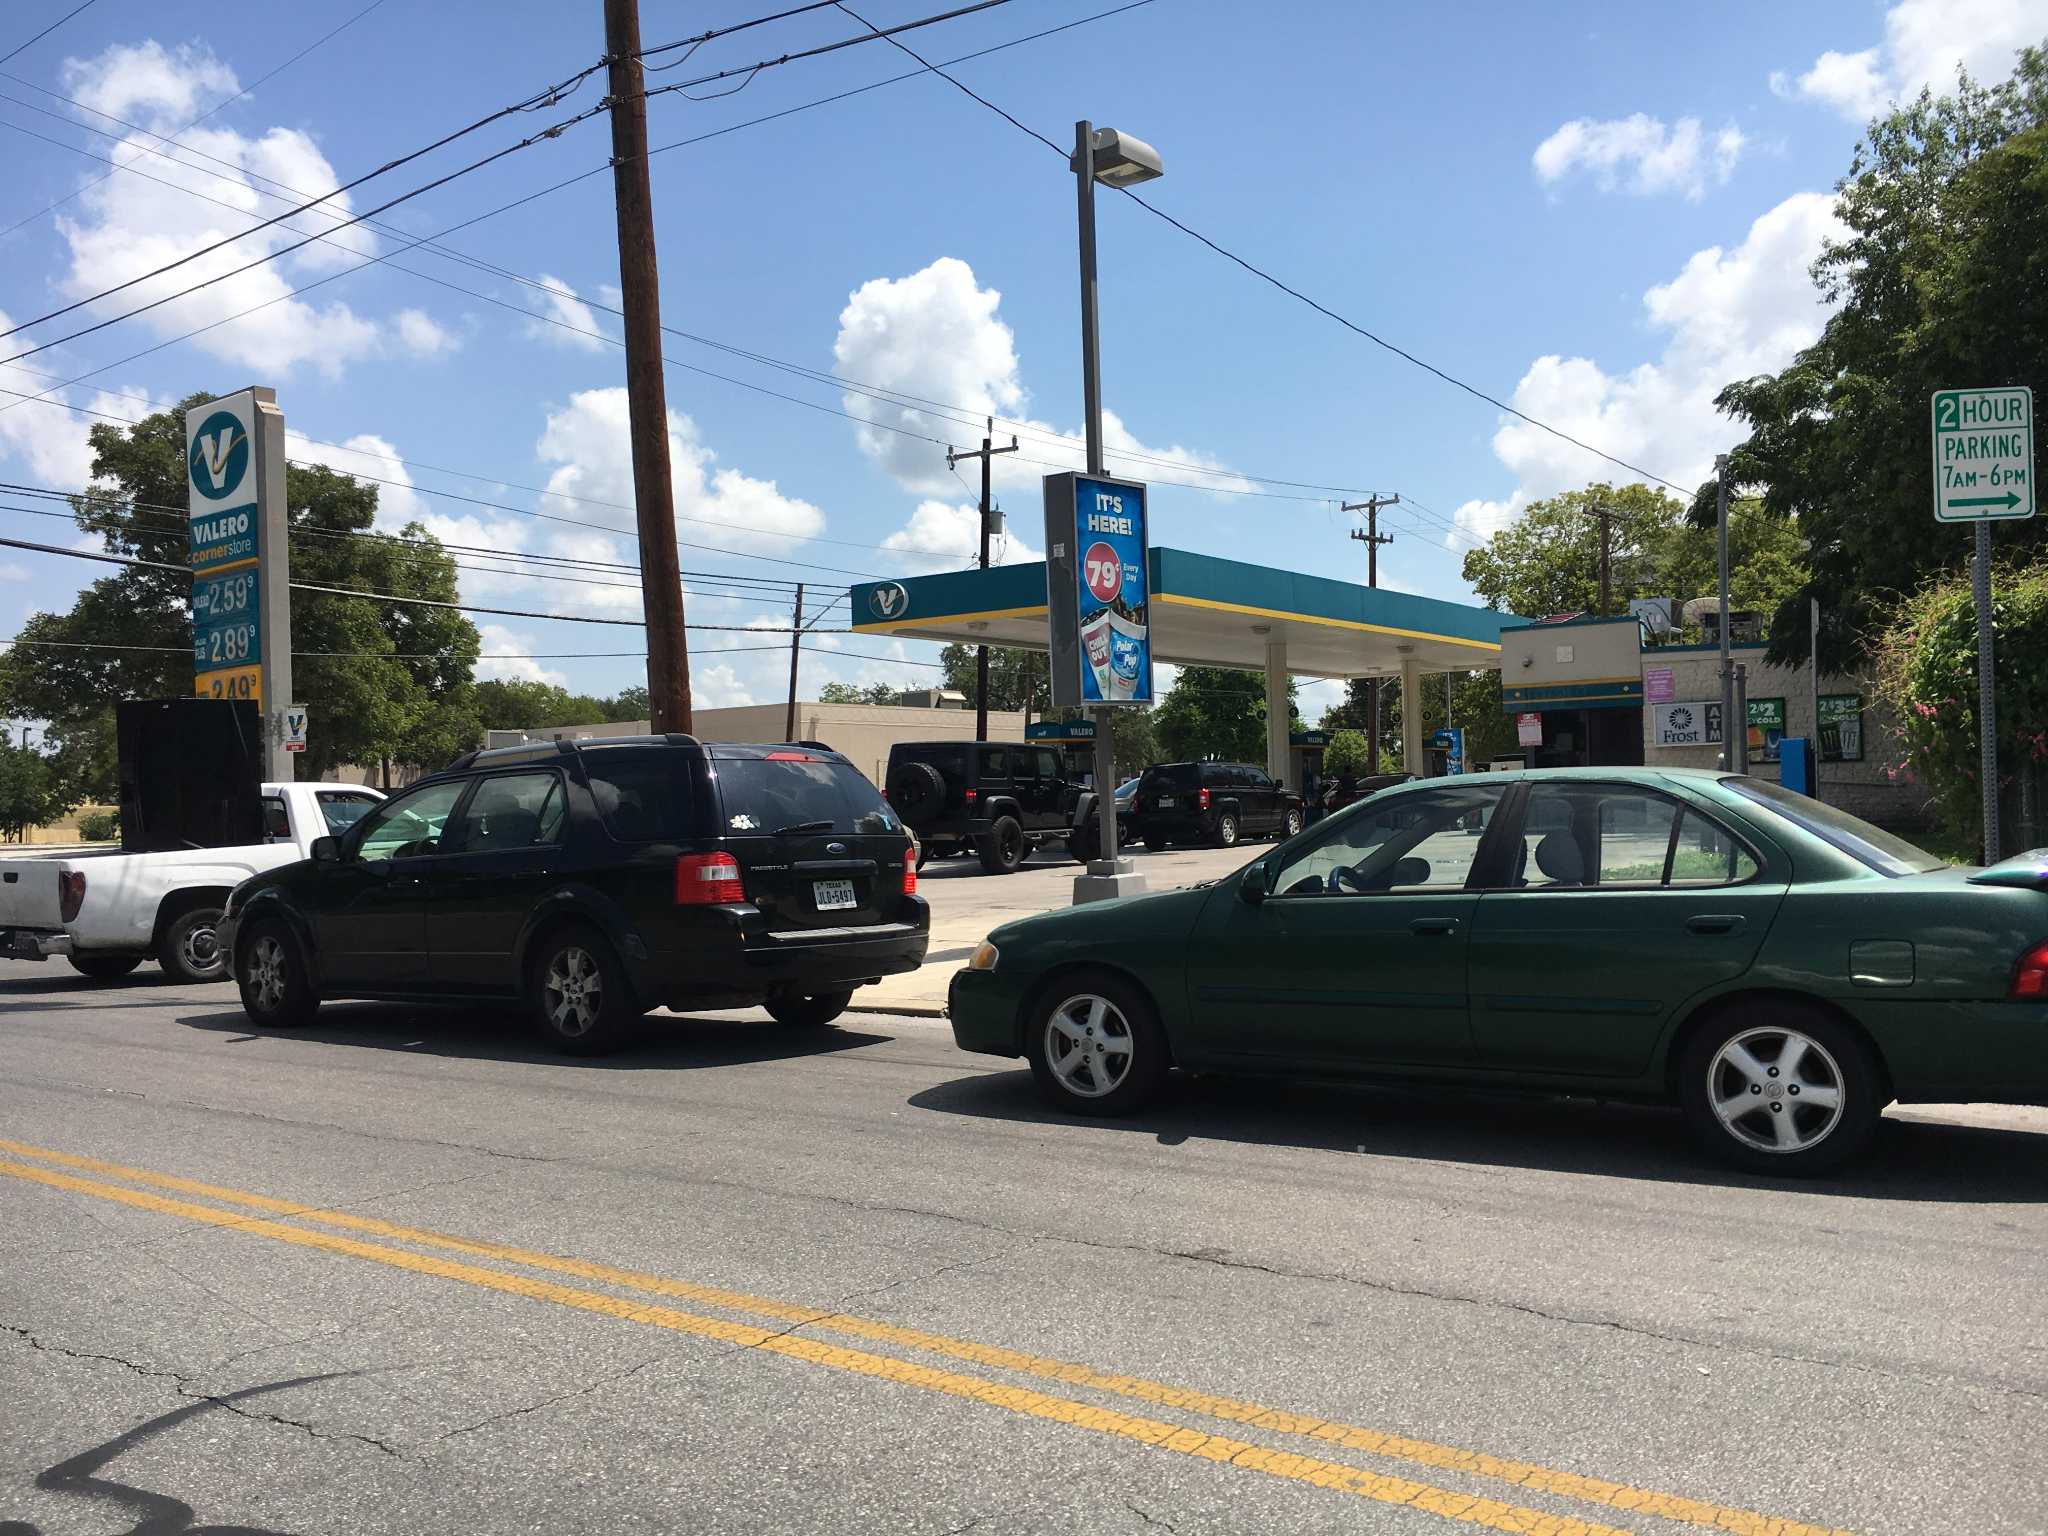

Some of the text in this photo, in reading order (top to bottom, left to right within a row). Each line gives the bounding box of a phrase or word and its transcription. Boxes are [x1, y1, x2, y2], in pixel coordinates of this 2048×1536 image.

[1939, 398, 2022, 428] 2 HOUR
[1945, 434, 2022, 461] PARKING
[1096, 494, 1123, 514] IT'S
[193, 513, 249, 545] VALERO
[1088, 514, 1132, 536] HERE!
[1123, 563, 1139, 574] Every
[1125, 573, 1137, 583] Day
[1116, 640, 1134, 652] Polar
[1091, 647, 1107, 660] OUT
[1124, 654, 1137, 668] Pop
[1709, 706, 1721, 741] ATM
[1070, 727, 1094, 736] VALERO
[1664, 730, 1700, 743] Frost
